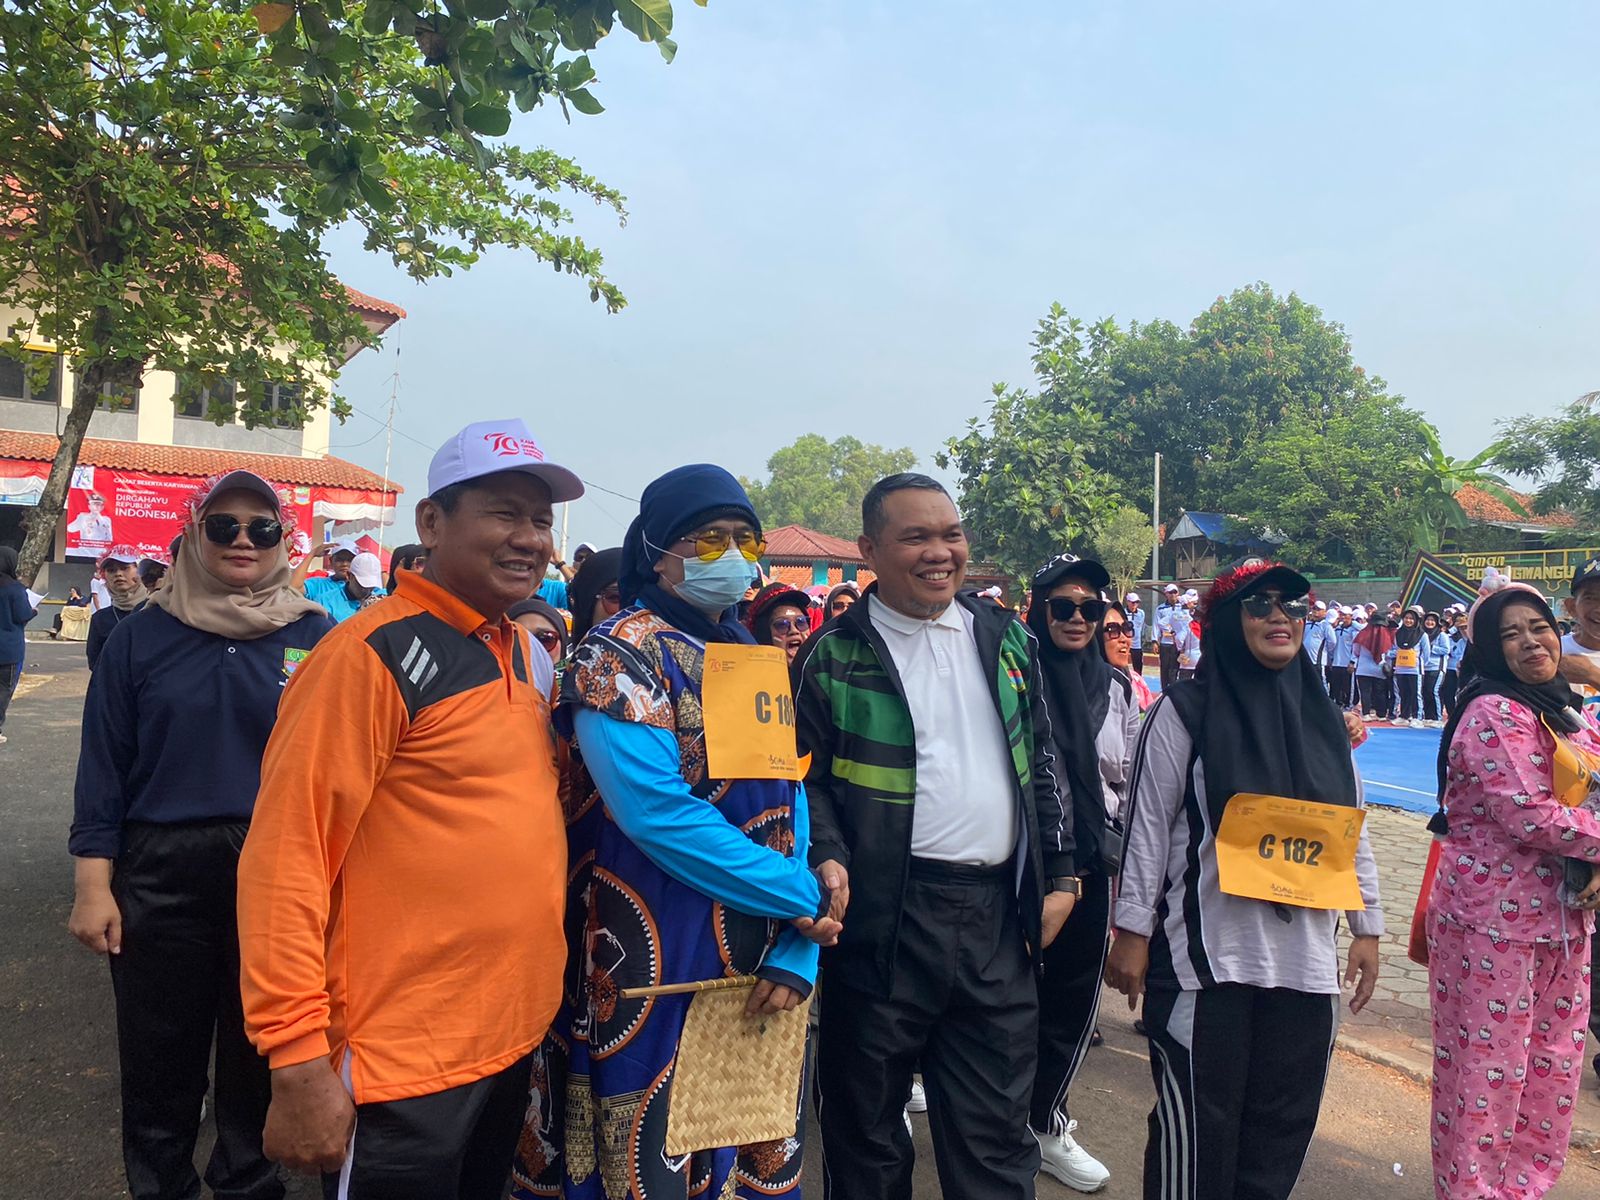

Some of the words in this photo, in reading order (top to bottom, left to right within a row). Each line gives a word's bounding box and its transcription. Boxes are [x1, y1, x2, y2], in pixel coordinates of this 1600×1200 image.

[116, 494, 168, 504] DIRGAHAYU
[115, 508, 177, 519] INDONESIA
[755, 691, 771, 724] C
[1259, 834, 1276, 859] C
[1281, 837, 1323, 866] 182
